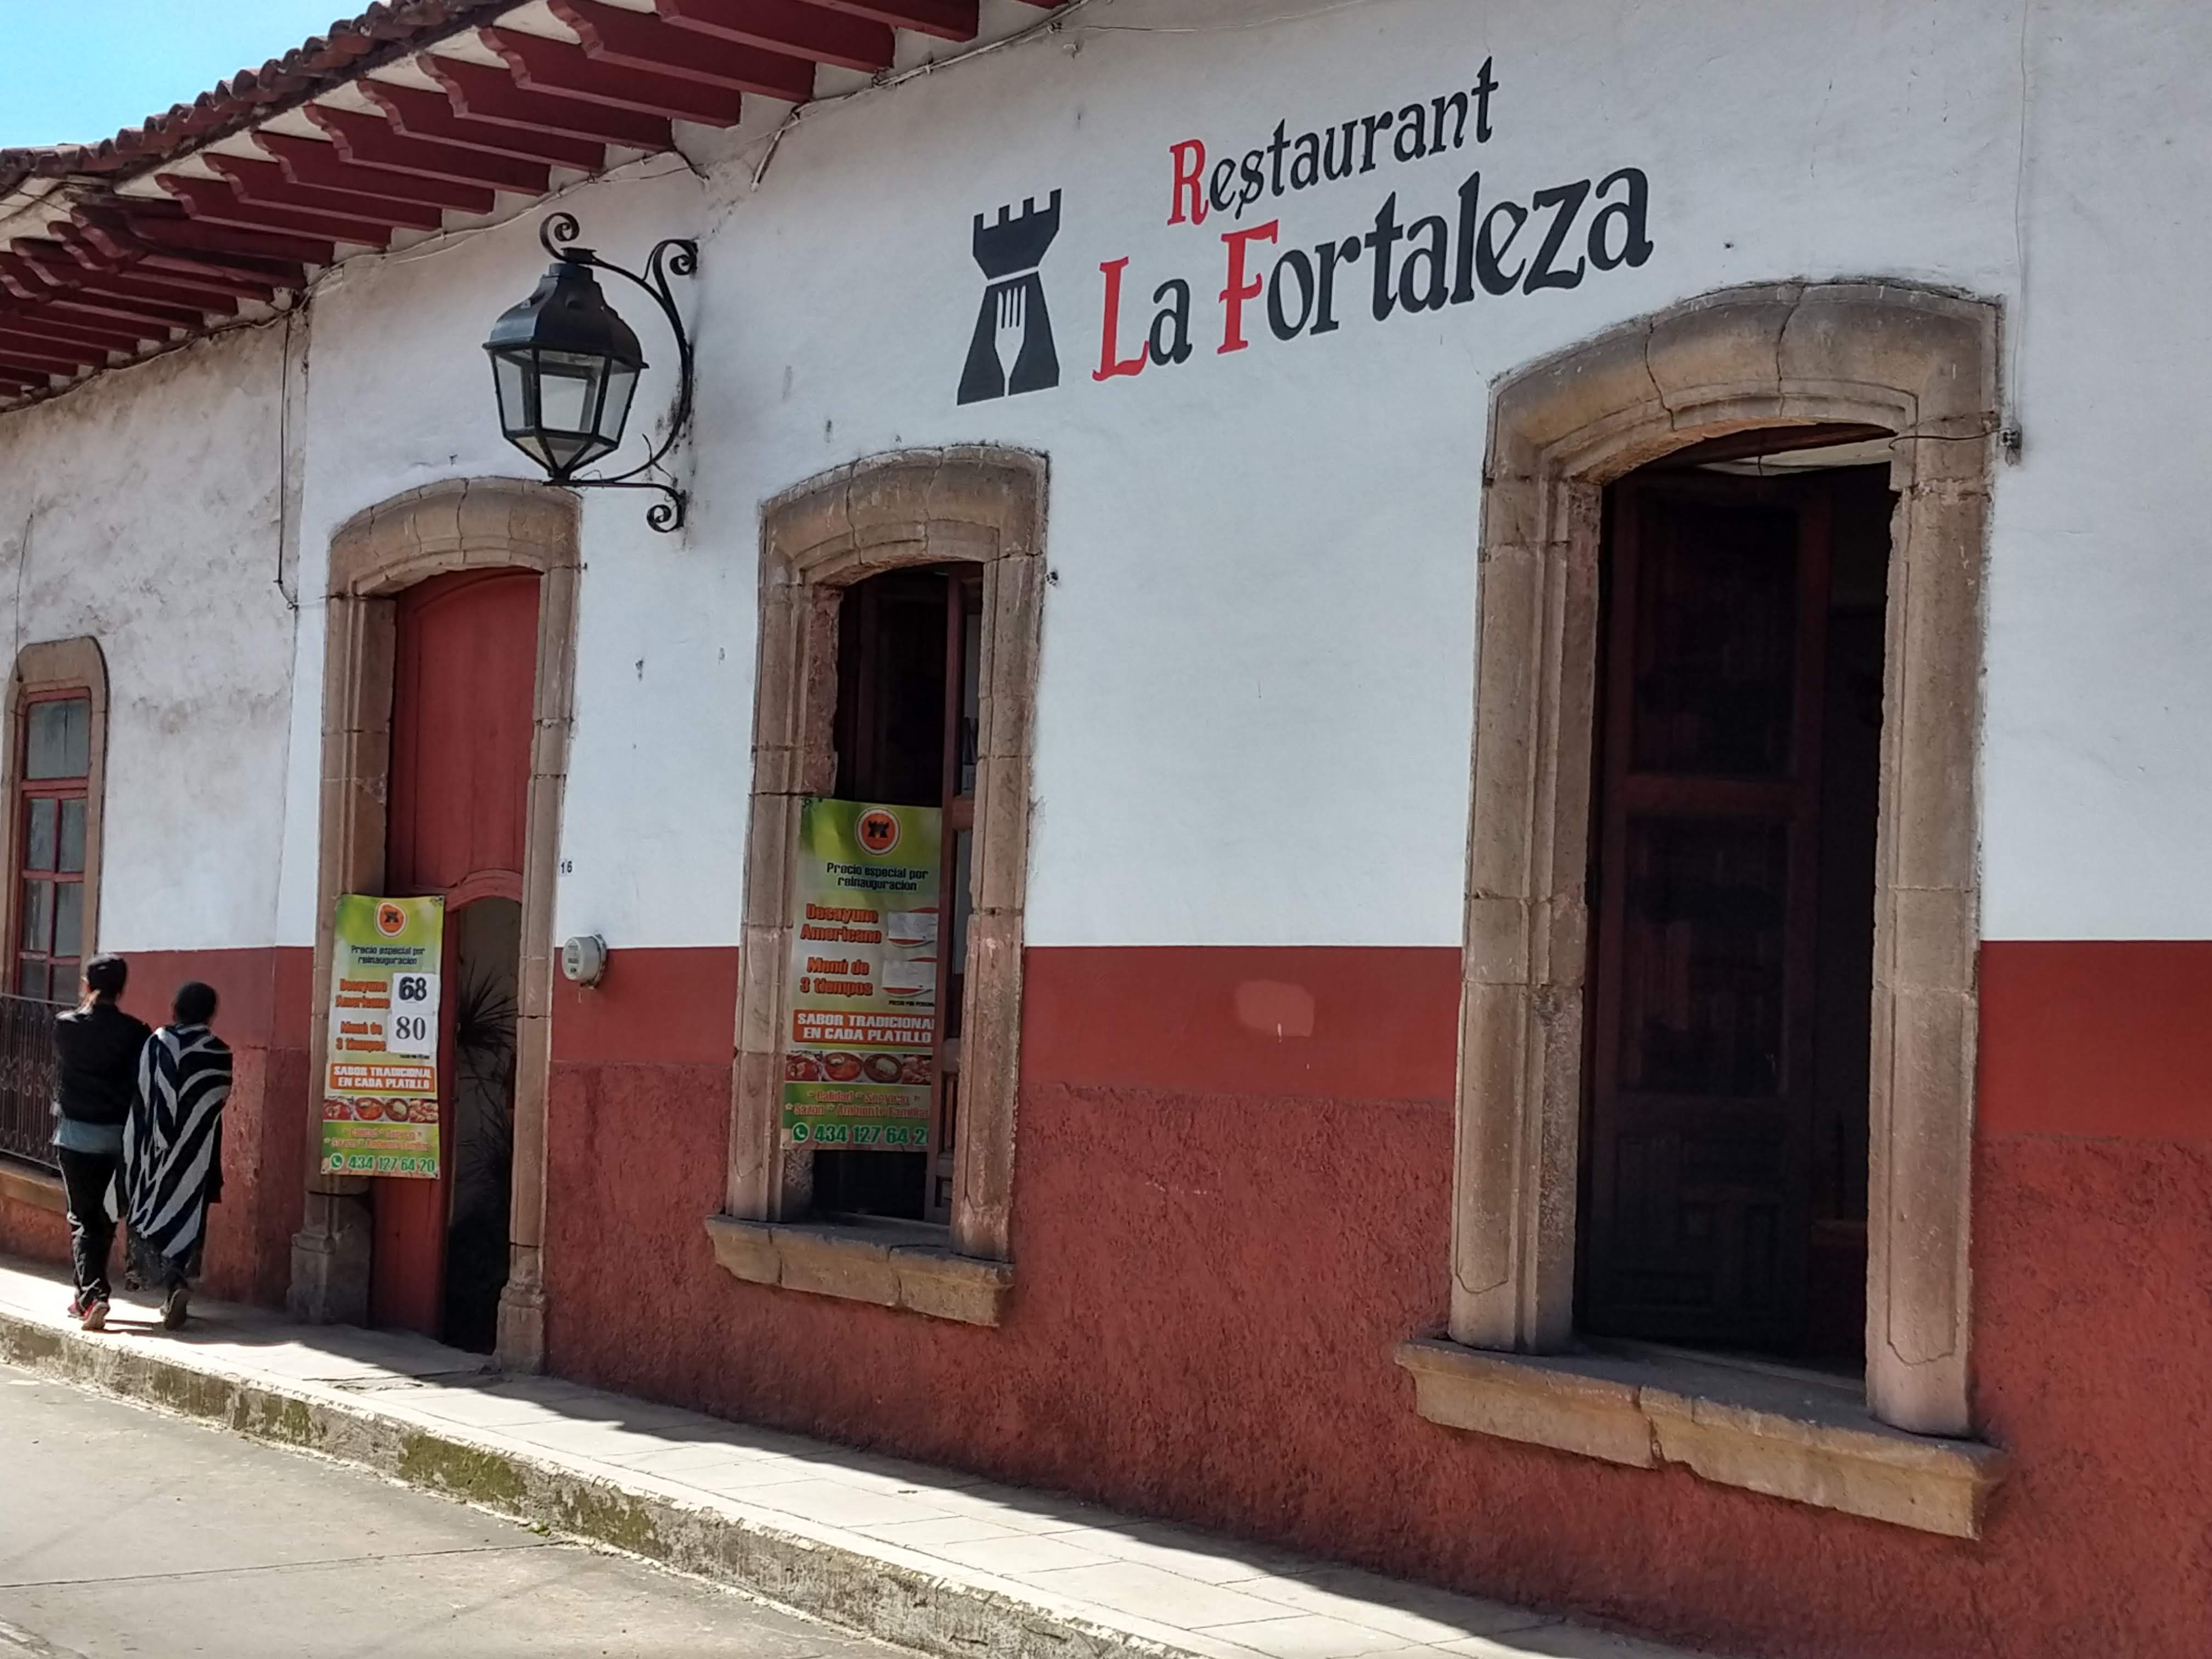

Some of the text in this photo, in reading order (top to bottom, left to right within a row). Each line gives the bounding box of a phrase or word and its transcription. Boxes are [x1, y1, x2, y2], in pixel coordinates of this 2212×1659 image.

[1167, 55, 1498, 226] Restaurant
[1092, 167, 1654, 381] La Fortaleza
[561, 861, 572, 873] 16
[827, 862, 929, 880] Precio especial por
[806, 904, 879, 924] Desayuno
[800, 924, 882, 944] Americano
[351, 945, 377, 954] Precio
[851, 959, 870, 975] de
[398, 976, 427, 1001] 68
[800, 977, 873, 997] 3 tiempos
[396, 1016, 426, 1040] 80
[797, 1013, 844, 1026] SABOR
[803, 1027, 932, 1043] EN CADA PLATILLO
[334, 1066, 368, 1076] SABOR
[338, 1077, 430, 1089] EN CADA PLATILLO
[814, 1125, 847, 1142] 434
[854, 1126, 881, 1143] 127
[885, 1127, 909, 1144] 64
[348, 1156, 435, 1172] 434 127 64 20
